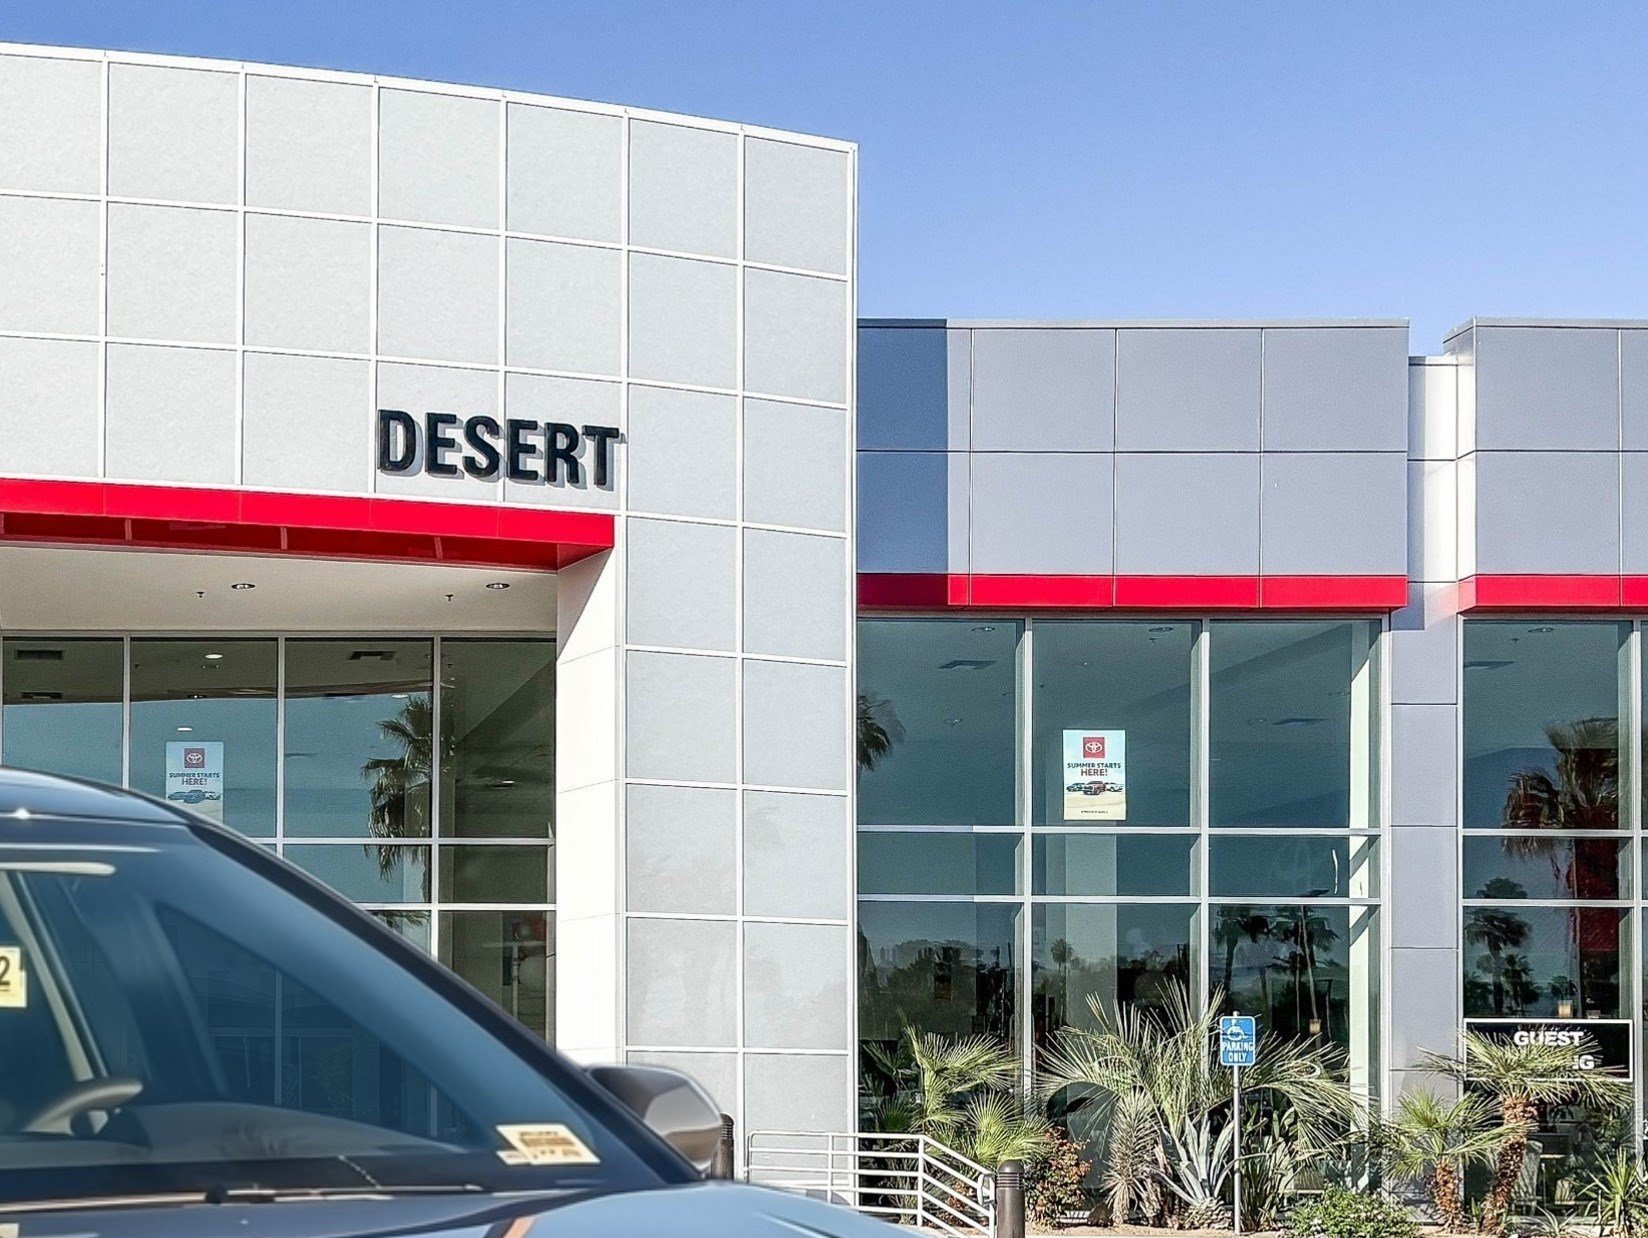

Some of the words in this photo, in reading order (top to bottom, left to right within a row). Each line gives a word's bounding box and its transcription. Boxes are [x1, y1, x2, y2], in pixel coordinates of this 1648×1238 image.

[377, 409, 619, 486] DESERT
[1514, 1031, 1584, 1047] GUEST
[1222, 1041, 1254, 1052] PARKING
[1228, 1052, 1247, 1062] ONLY
